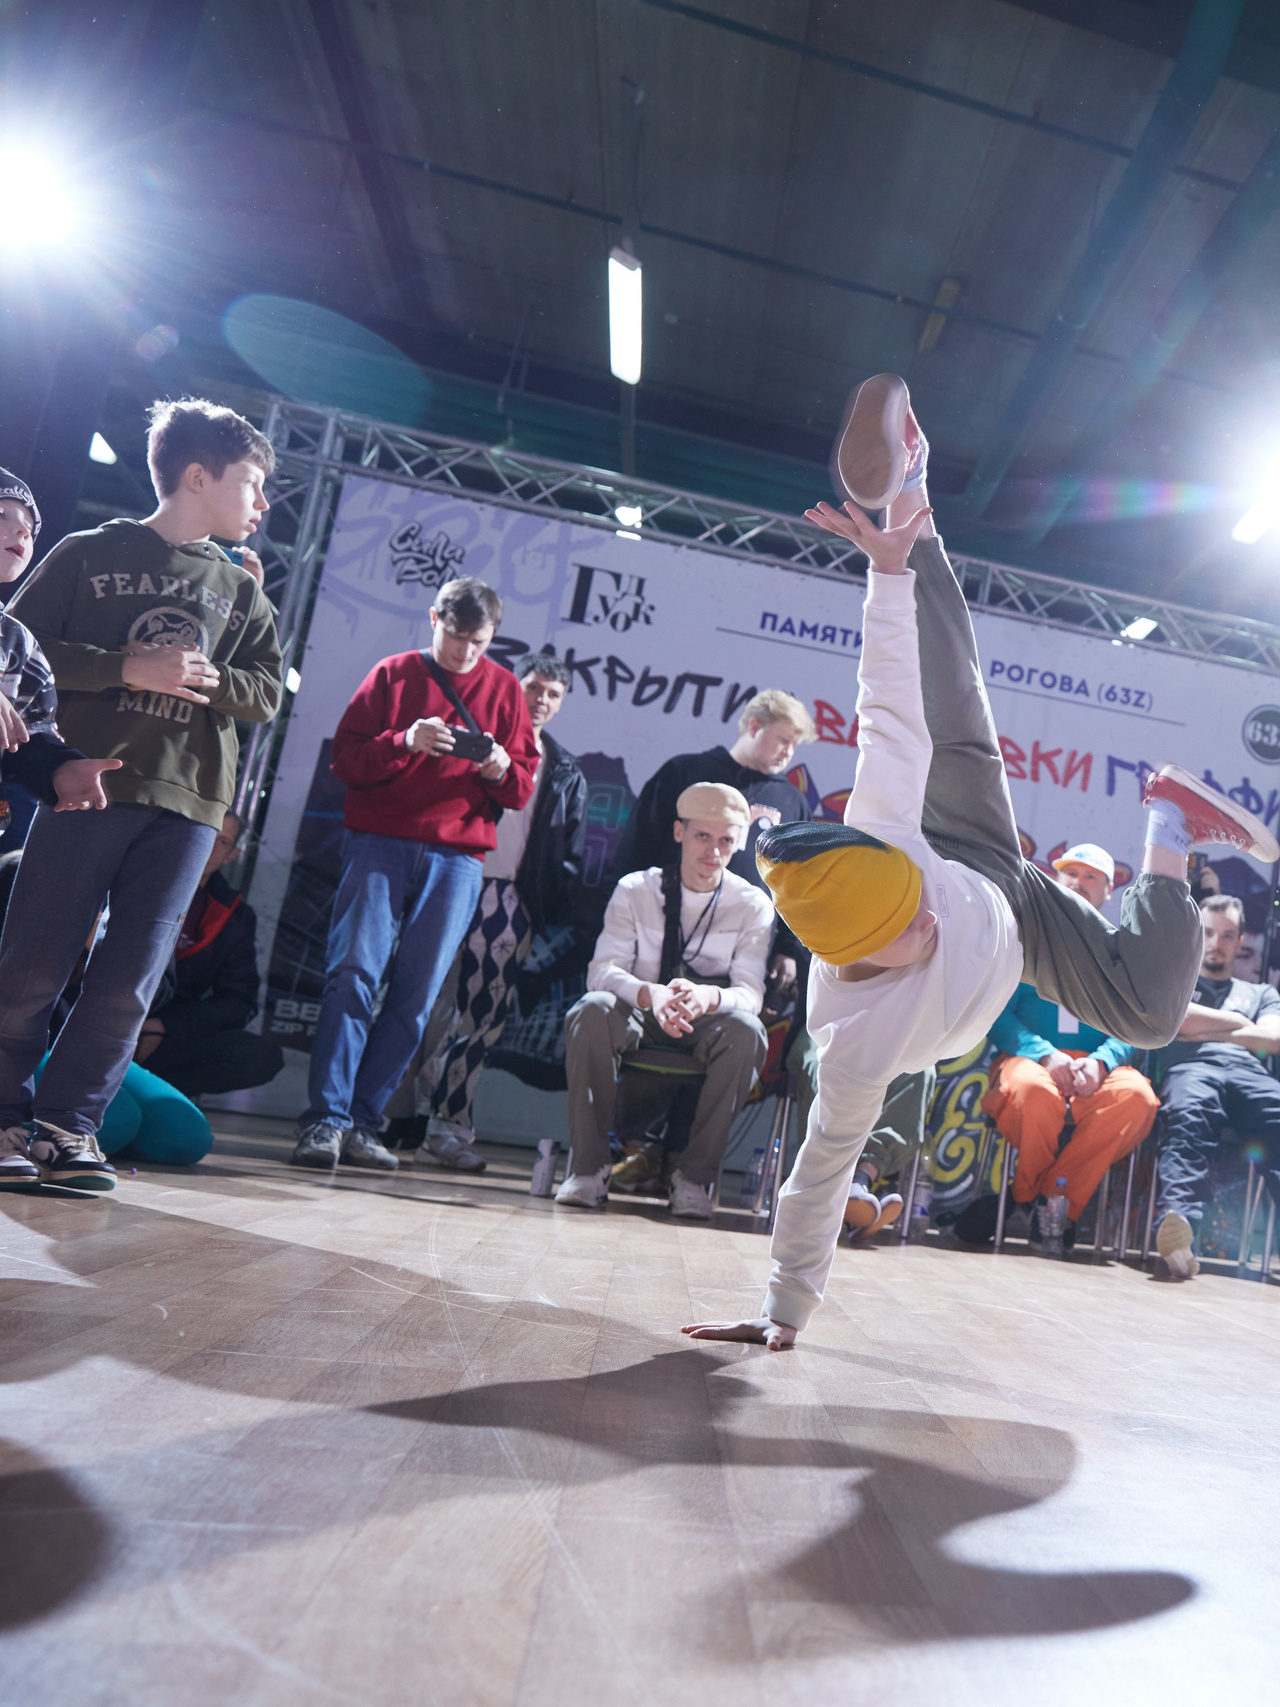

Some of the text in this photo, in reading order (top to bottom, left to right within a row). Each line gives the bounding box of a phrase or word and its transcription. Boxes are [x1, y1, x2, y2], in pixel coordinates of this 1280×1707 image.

[391, 550, 459, 590] Вол
[90, 573, 246, 631] FEARLESS
[116, 691, 194, 724] MIND
[989, 660, 1154, 713] РОГОВА (63Z)
